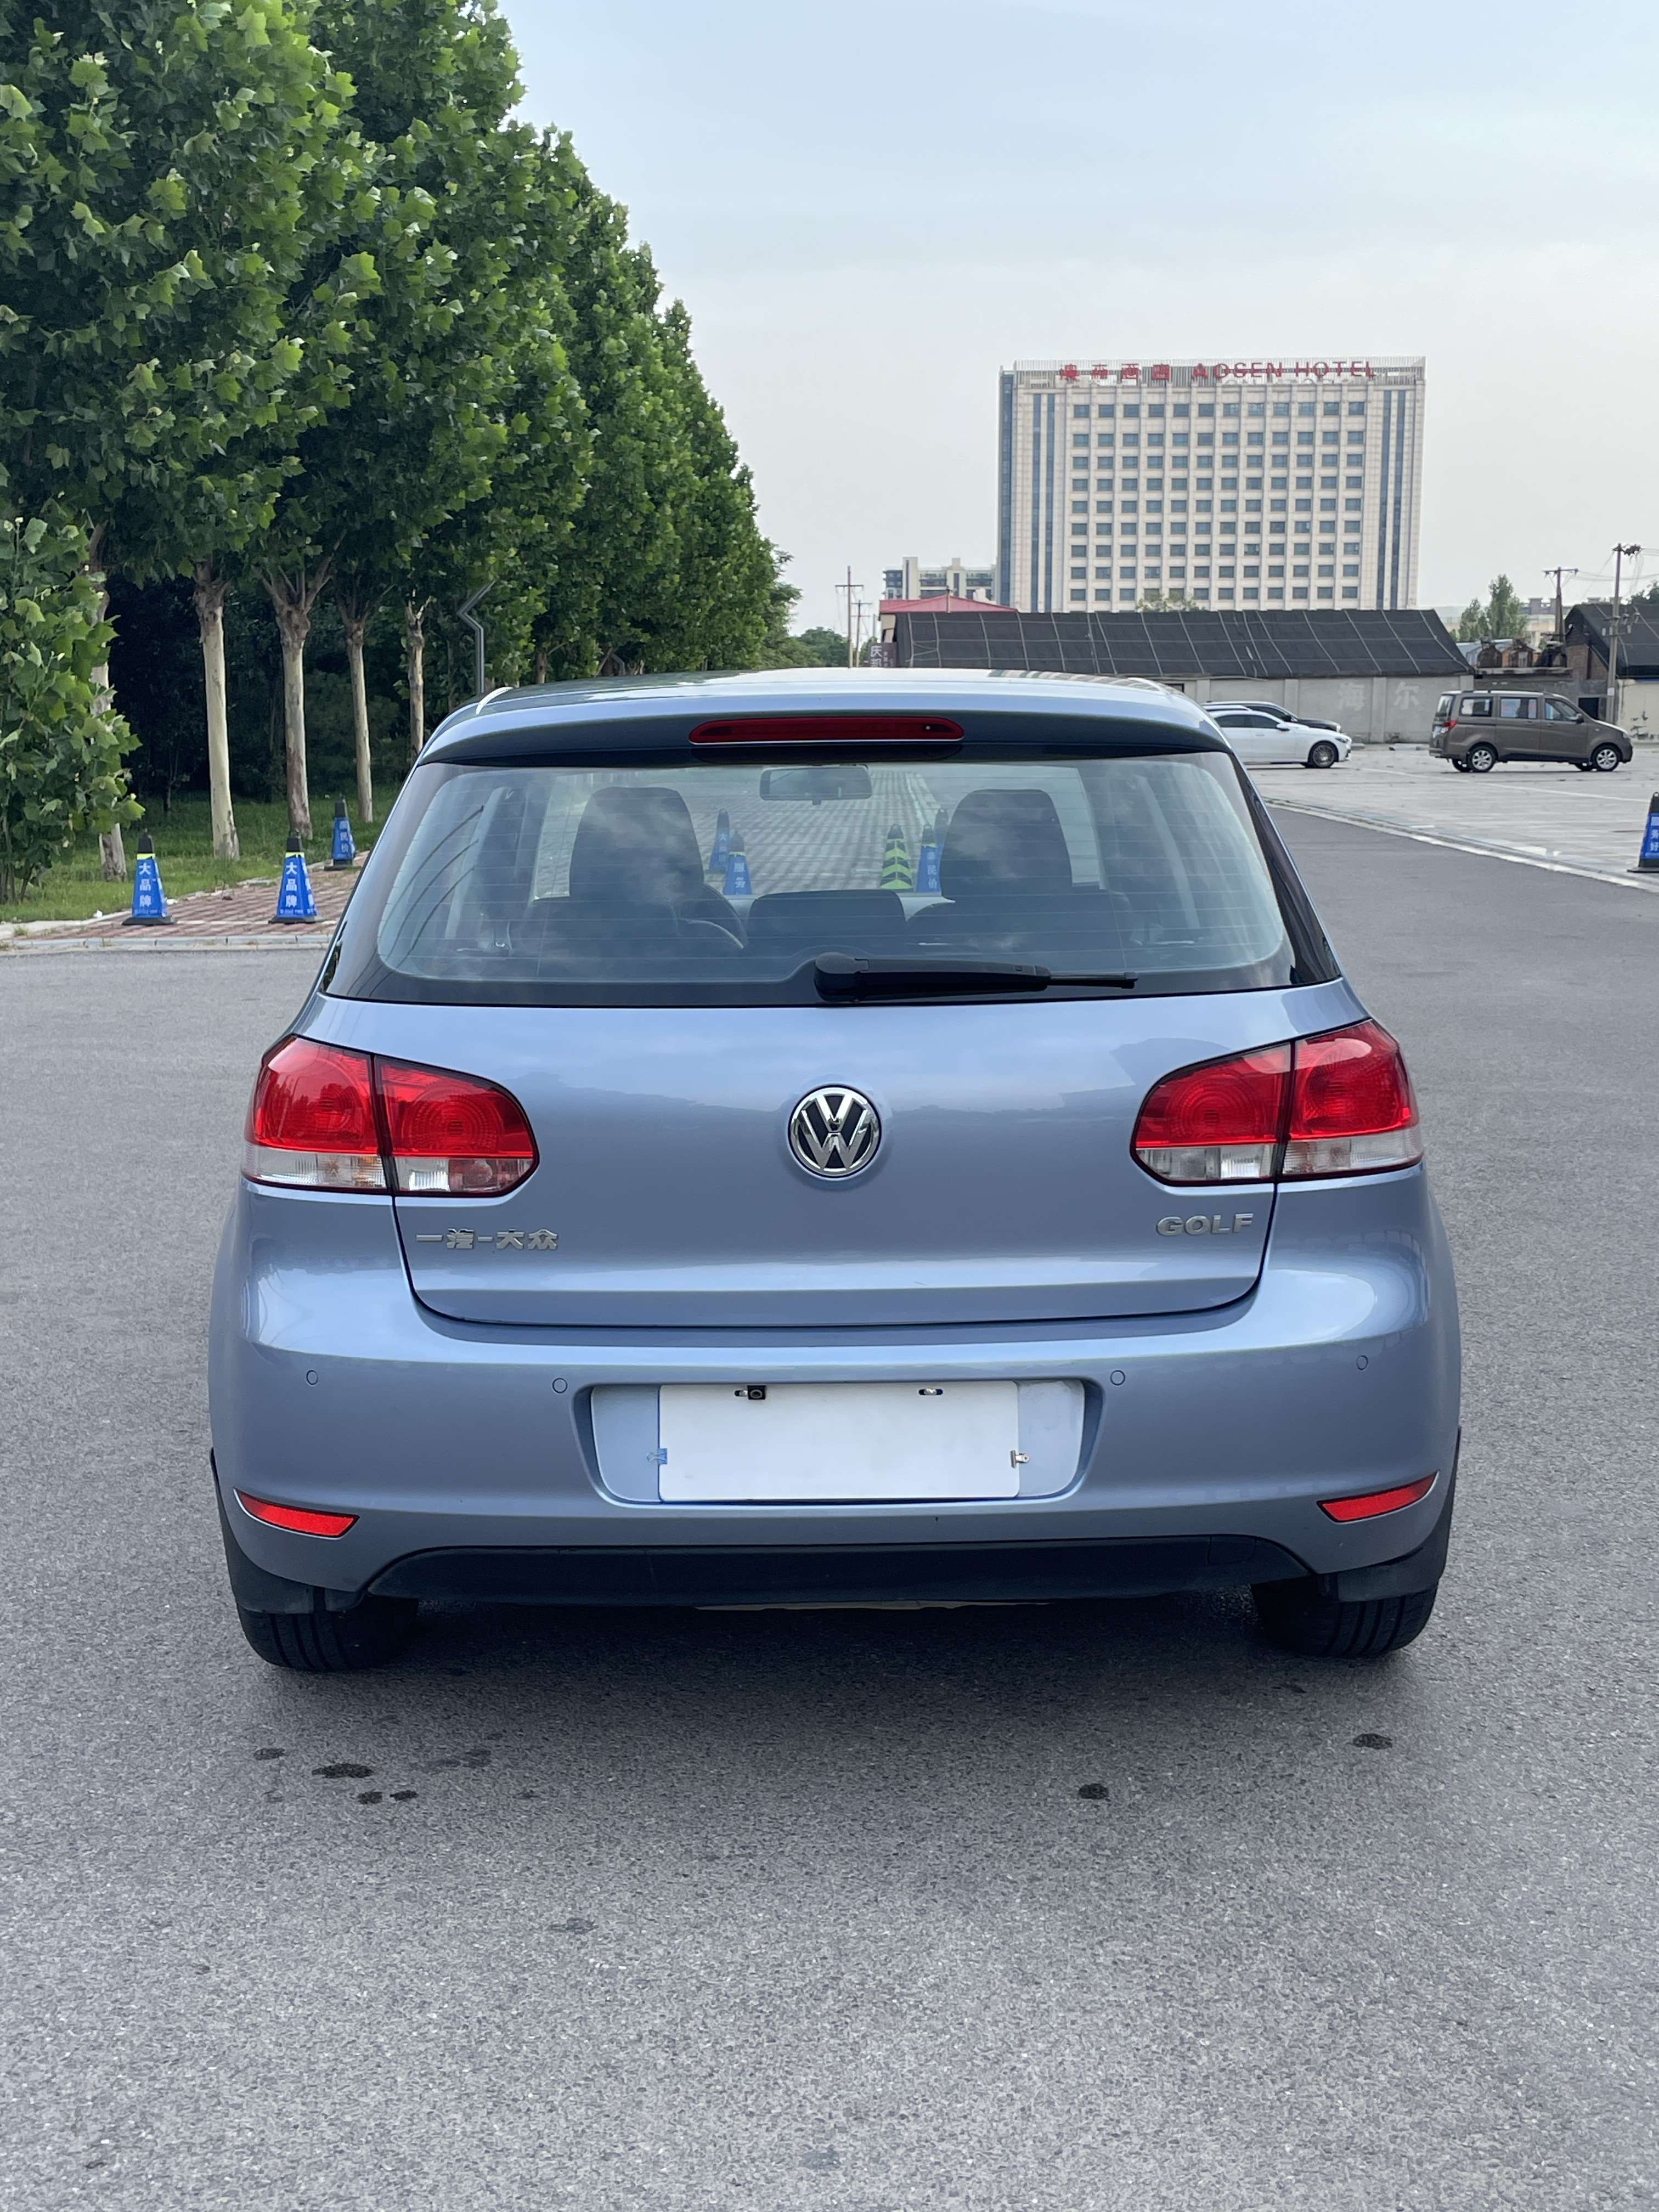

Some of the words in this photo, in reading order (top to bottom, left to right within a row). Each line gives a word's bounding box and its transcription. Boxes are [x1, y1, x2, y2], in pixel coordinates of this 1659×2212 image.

[1191, 362, 1283, 380] AOSEN
[1294, 361, 1376, 379] HOTEL
[139, 862, 151, 907] 大品牌
[285, 861, 297, 907] 大品牌
[734, 862, 746, 894] 服务
[1158, 1213, 1254, 1235] GOLF
